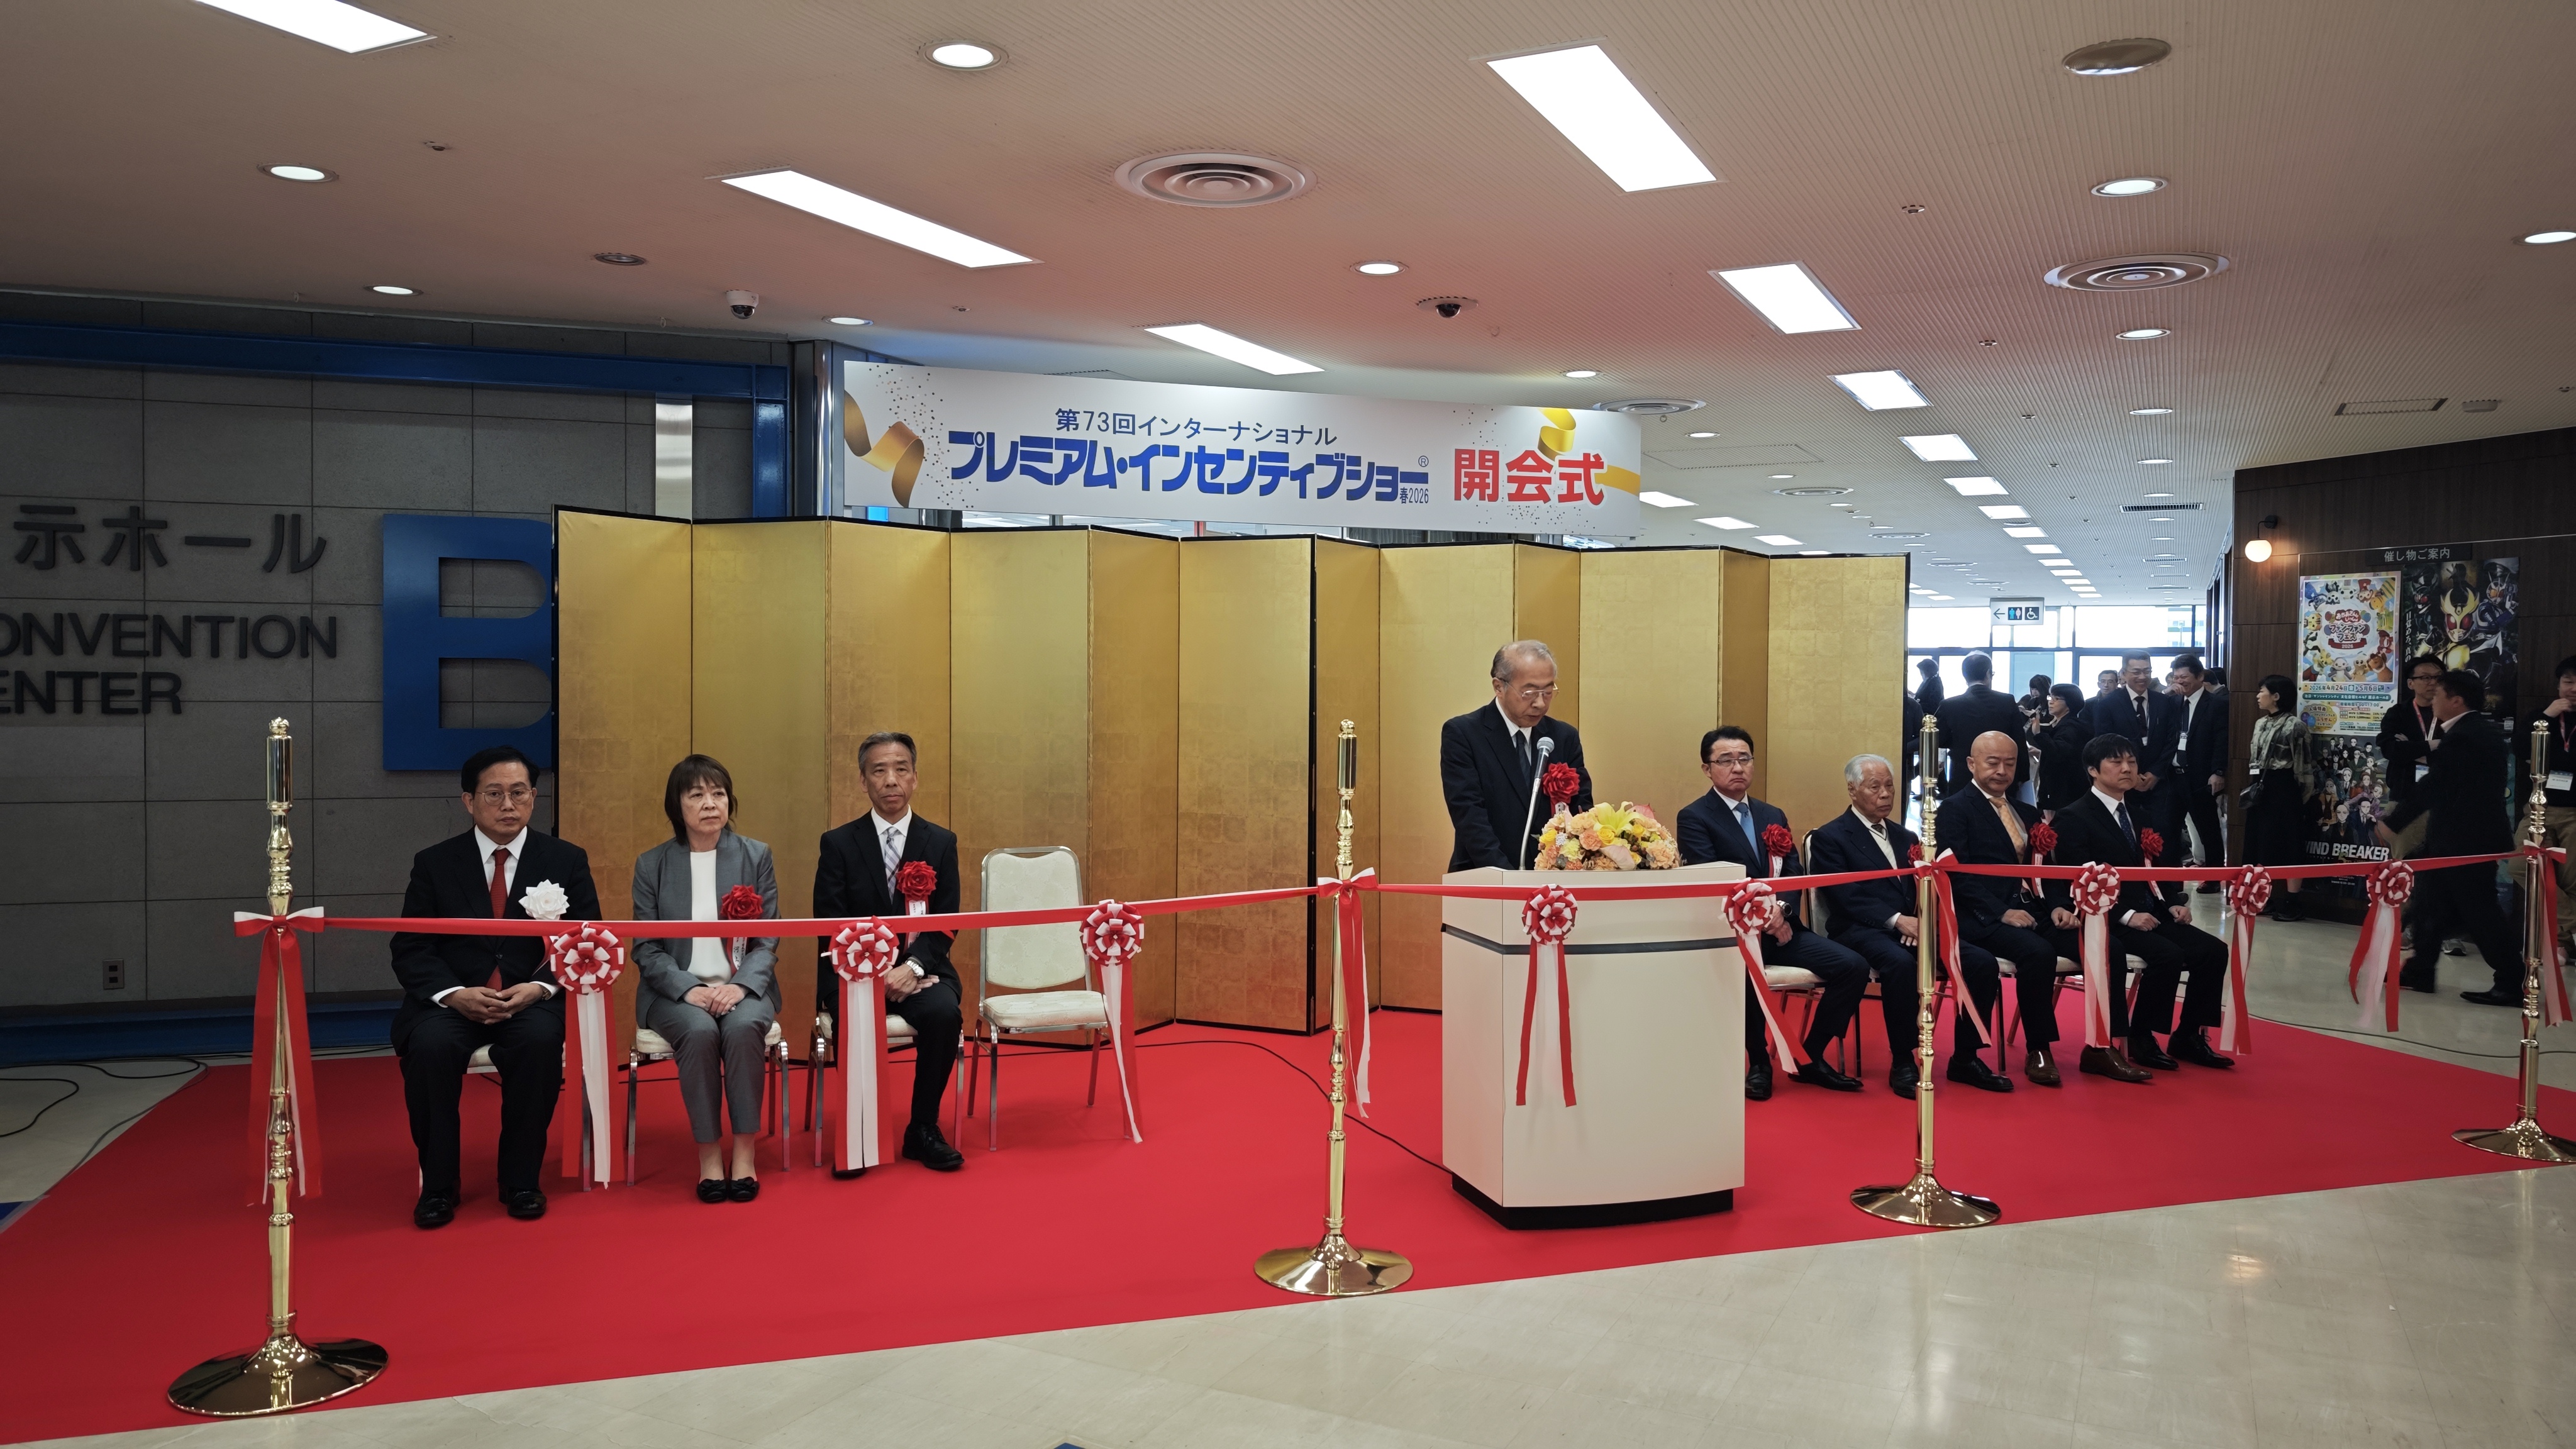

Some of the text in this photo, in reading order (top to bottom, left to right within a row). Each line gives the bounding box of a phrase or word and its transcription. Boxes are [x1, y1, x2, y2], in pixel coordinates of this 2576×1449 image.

[1055, 408, 1338, 446] 第73回インターナショナル
[1454, 448, 1604, 506] 開会式
[1400, 487, 1429, 504] 春2026
[2384, 548, 2450, 562] 催し物ご案内
[383, 514, 552, 770] B
[2337, 633, 2357, 641] フェス
[2332, 843, 2390, 861] BREAKER
